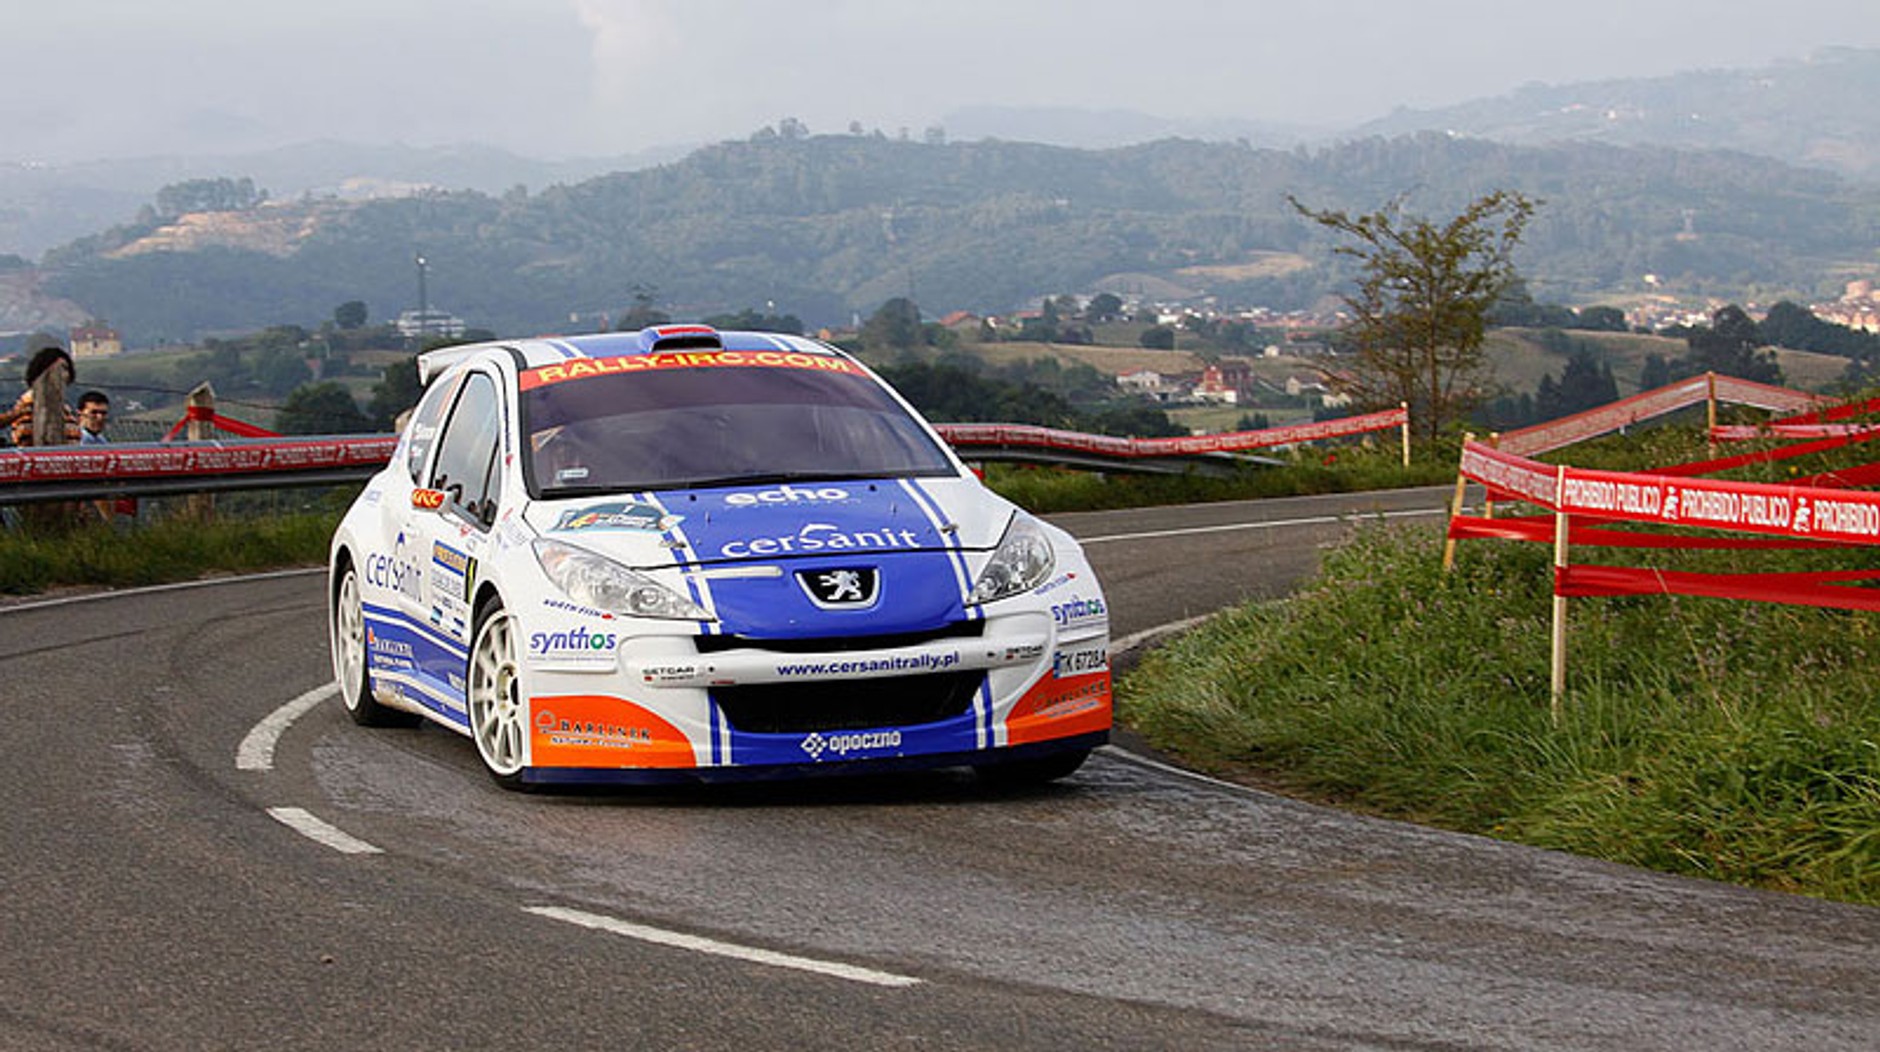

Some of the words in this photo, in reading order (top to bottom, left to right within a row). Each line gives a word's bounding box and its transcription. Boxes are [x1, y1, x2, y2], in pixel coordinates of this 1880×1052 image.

[538, 349, 850, 381] RALLY-IRC.COM
[725, 485, 849, 505] echo
[1564, 478, 1616, 510] PROHIBIDO
[1616, 483, 1661, 515] PUBLICO
[1680, 488, 1740, 523] PROHIBIDO
[1740, 493, 1790, 528] PUBLICO
[1813, 500, 1879, 536] PROHIBIDO
[530, 626, 617, 654] synthos
[777, 651, 960, 676] www.cersanitrally.pl
[829, 731, 901, 755] opoczno
